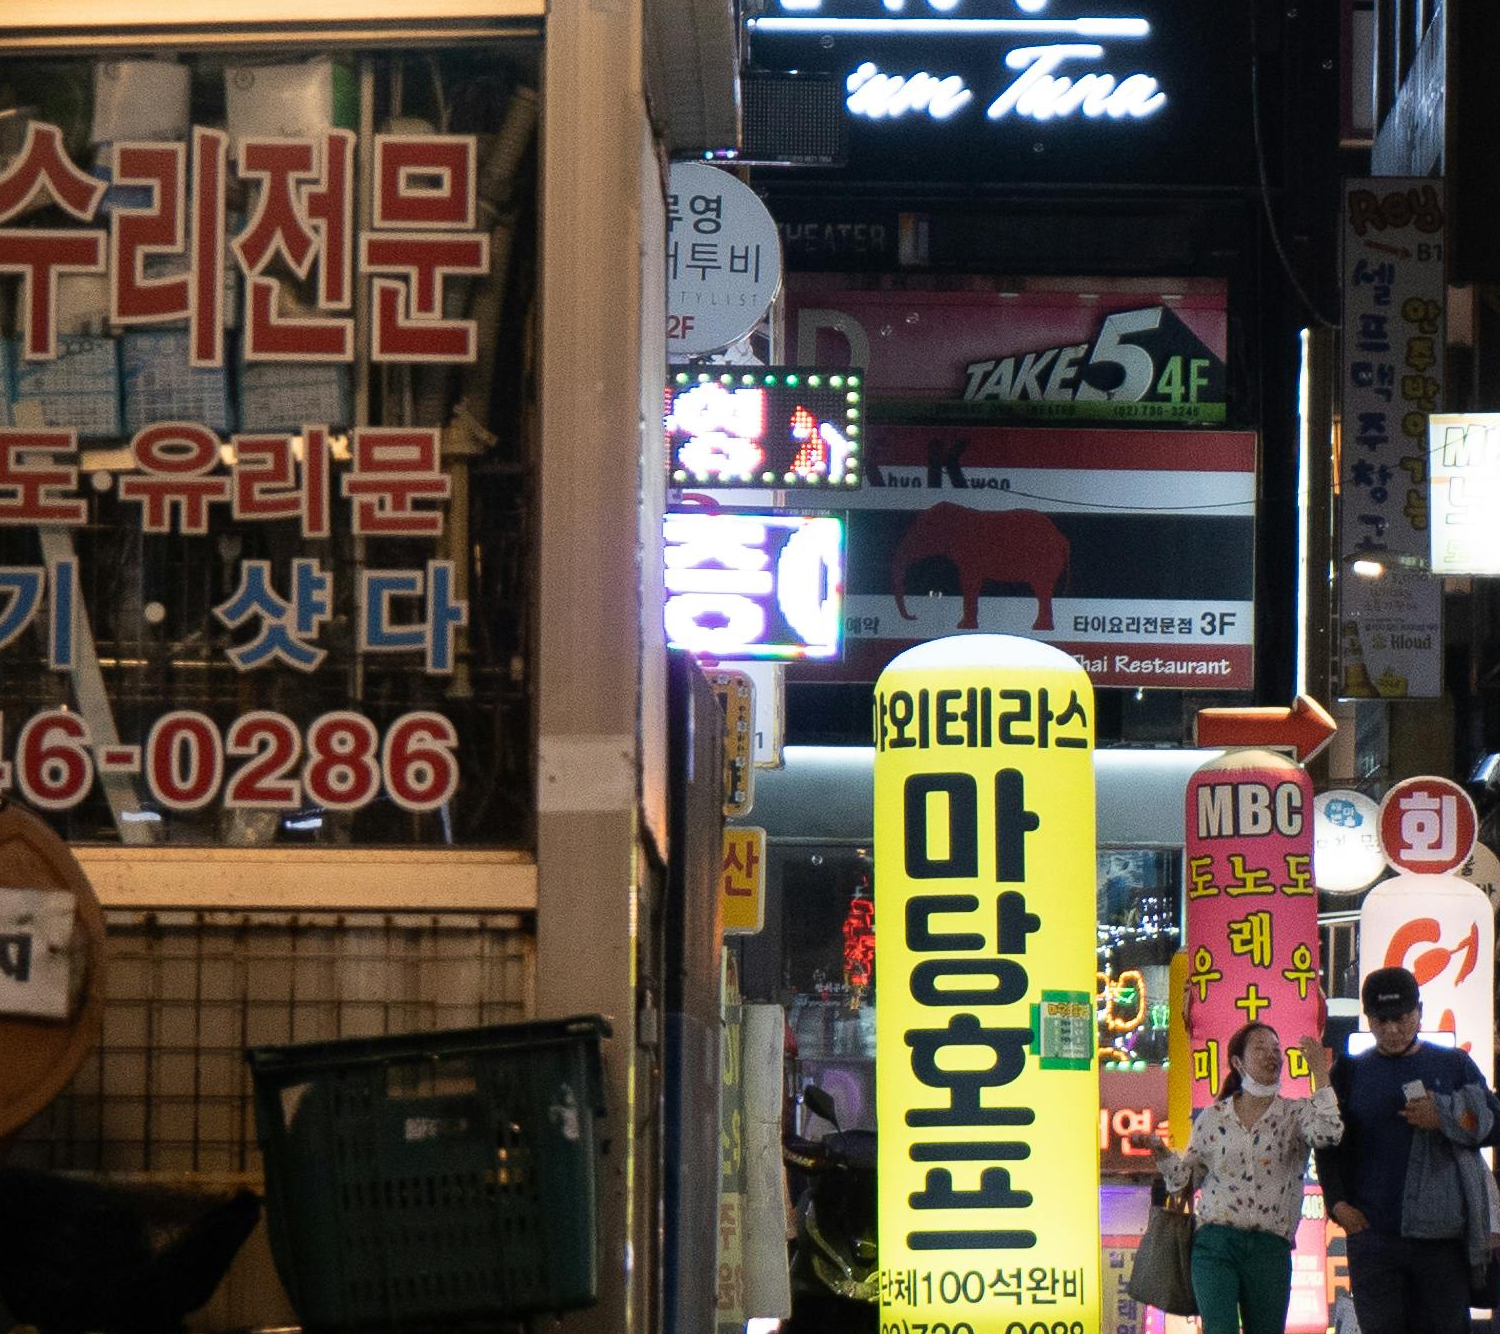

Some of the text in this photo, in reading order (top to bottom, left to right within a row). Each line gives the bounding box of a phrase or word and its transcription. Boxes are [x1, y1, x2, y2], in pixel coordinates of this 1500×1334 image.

[1155, 357, 1210, 403] 4F
[119, 421, 453, 539] 유리문
[1072, 611, 1237, 637] 타이요리전문점 3F
[1114, 654, 1231, 675] Restaurant
[1196, 780, 1306, 839] MBC
[1399, 792, 1457, 863] 회
[902, 767, 1042, 1252] 마당호프
